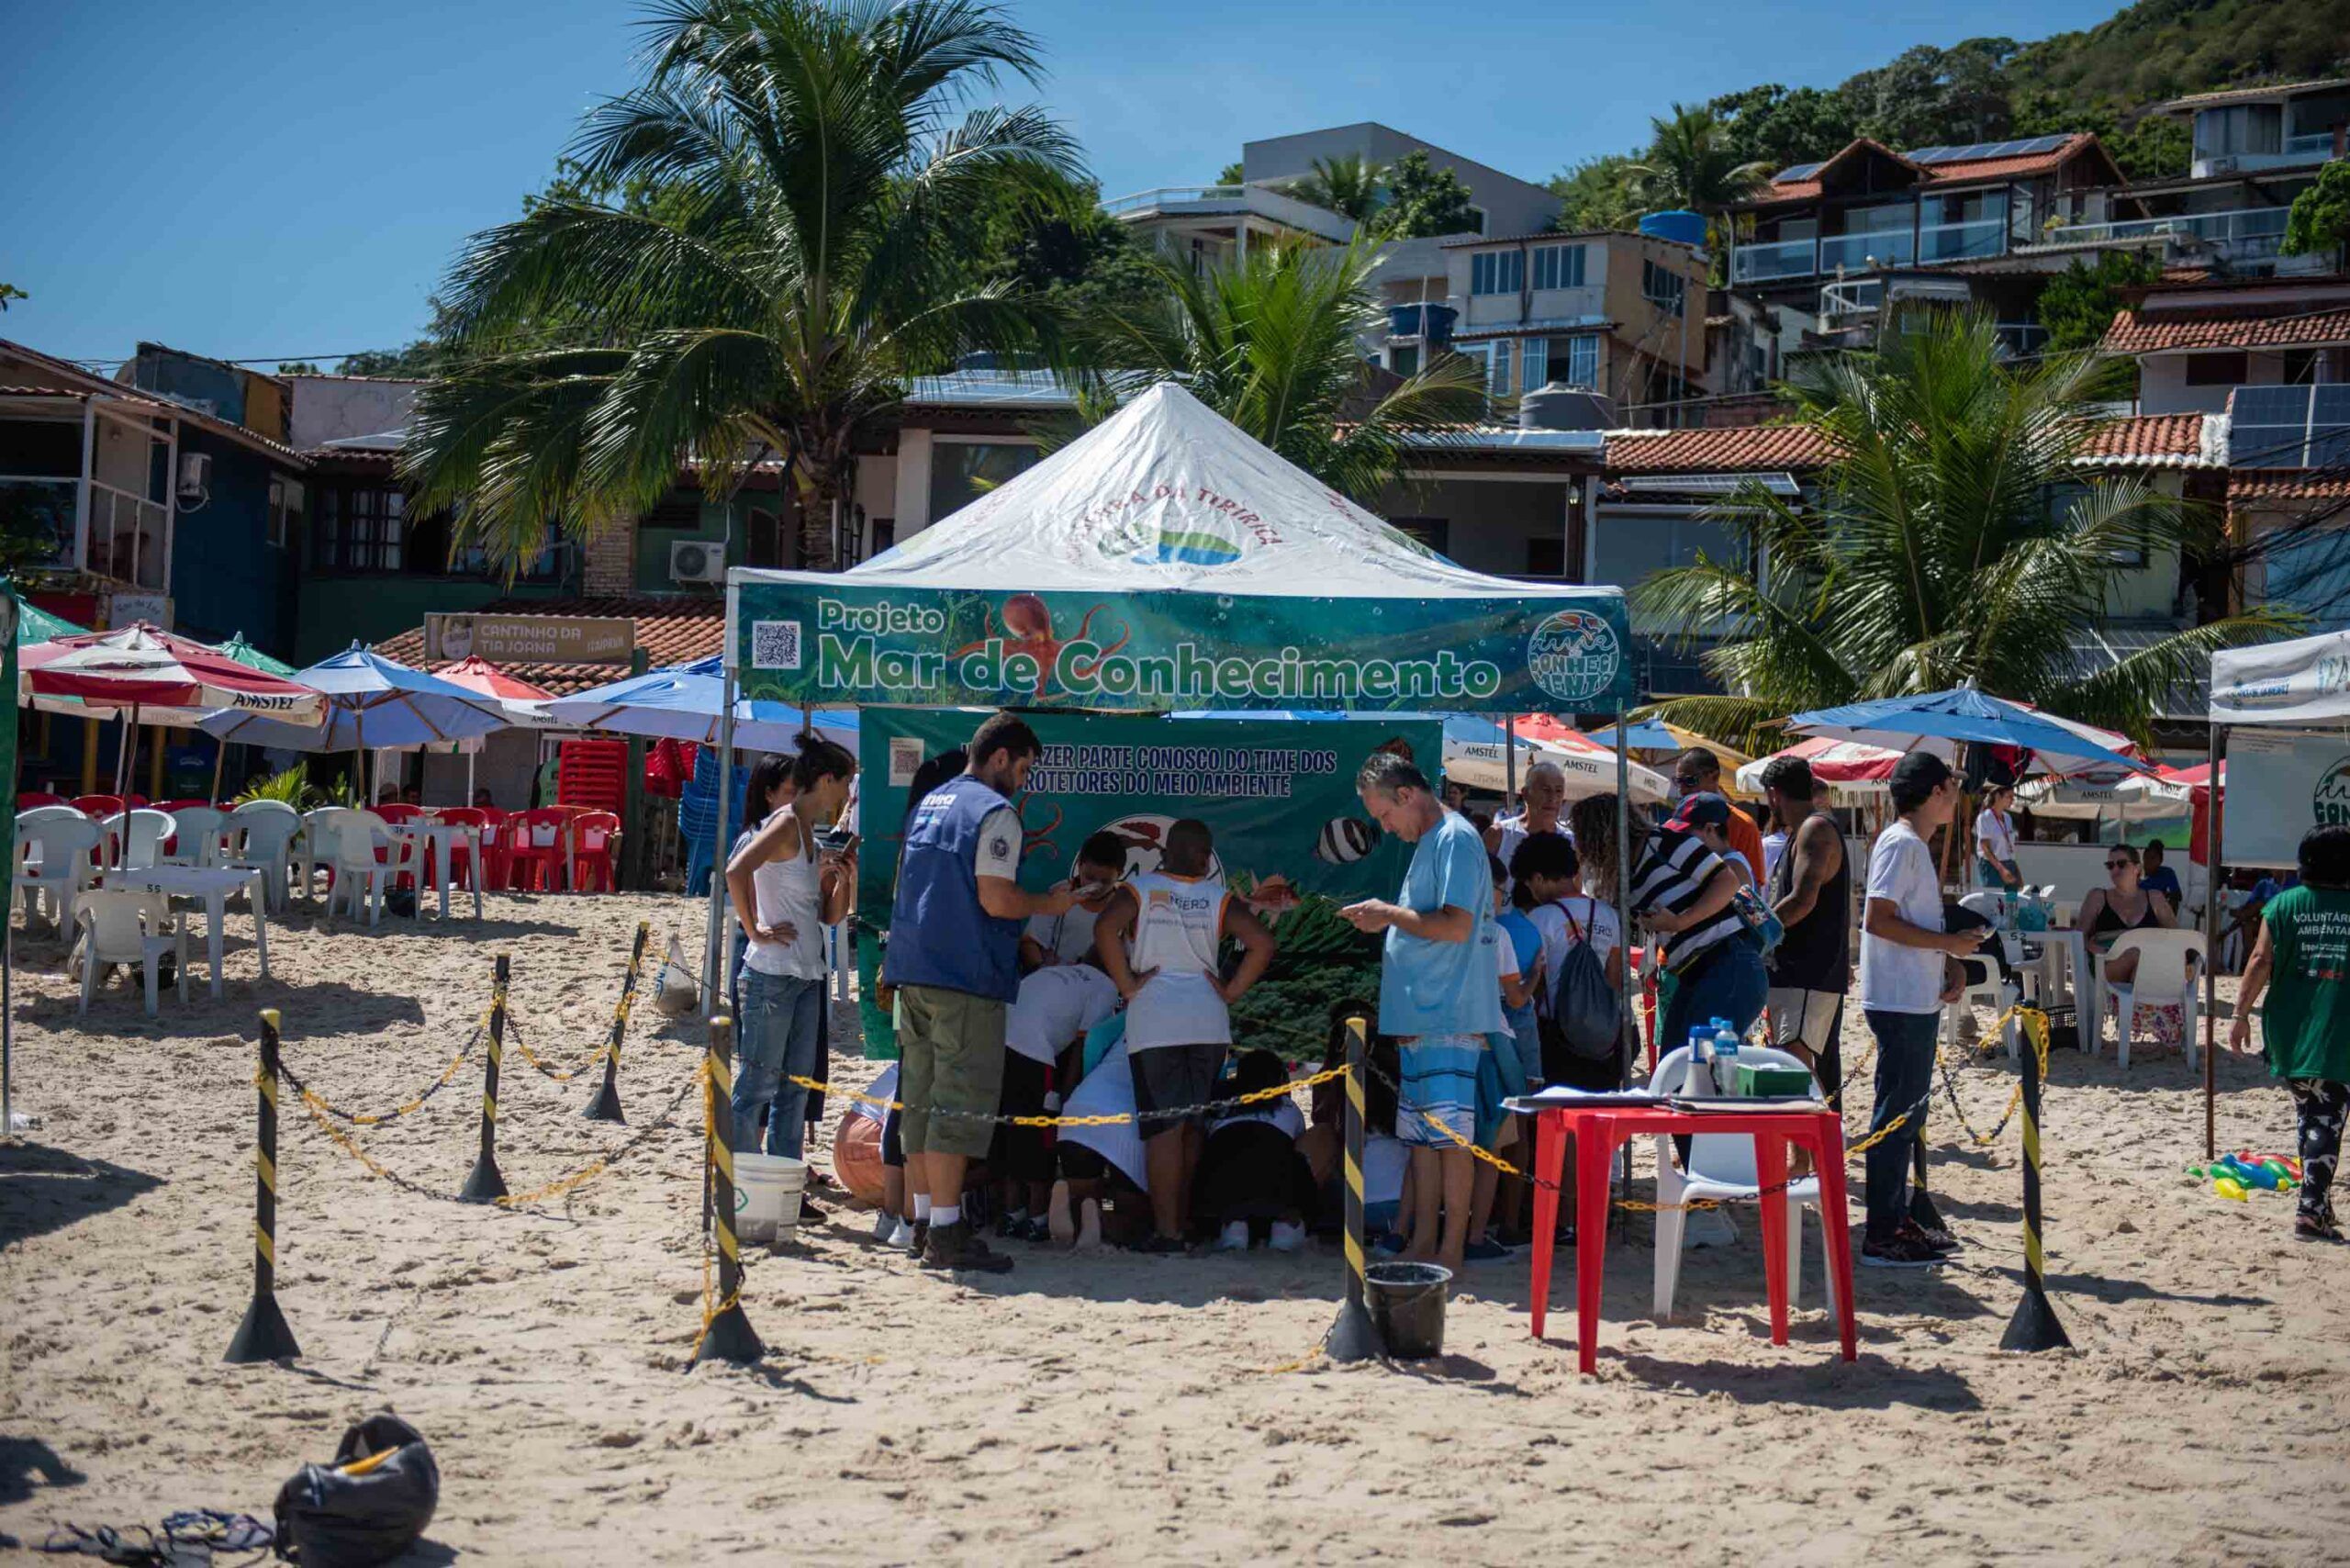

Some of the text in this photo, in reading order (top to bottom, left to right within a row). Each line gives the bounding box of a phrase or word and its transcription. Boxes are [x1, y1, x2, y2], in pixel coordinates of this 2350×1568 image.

[1198, 487, 1284, 545] TIRIRICA
[818, 599, 945, 636] Projeto
[480, 624, 582, 641] CANTINHO DA
[480, 641, 556, 655] TIA JOANA
[818, 633, 1502, 700] Mar de Conhecimento
[232, 693, 295, 711] AMSTEL
[531, 715, 559, 724] AMSTEL
[1031, 745, 1337, 773] AZER PARTE CONOSCO DO TIME DOS
[1464, 746, 1499, 759] AMSTEL
[1563, 759, 1599, 774] AMSTEL
[1024, 768, 1292, 798] ROTETORES DO MEIO AMBIENTE
[2081, 790, 2113, 800] AMSTEL
